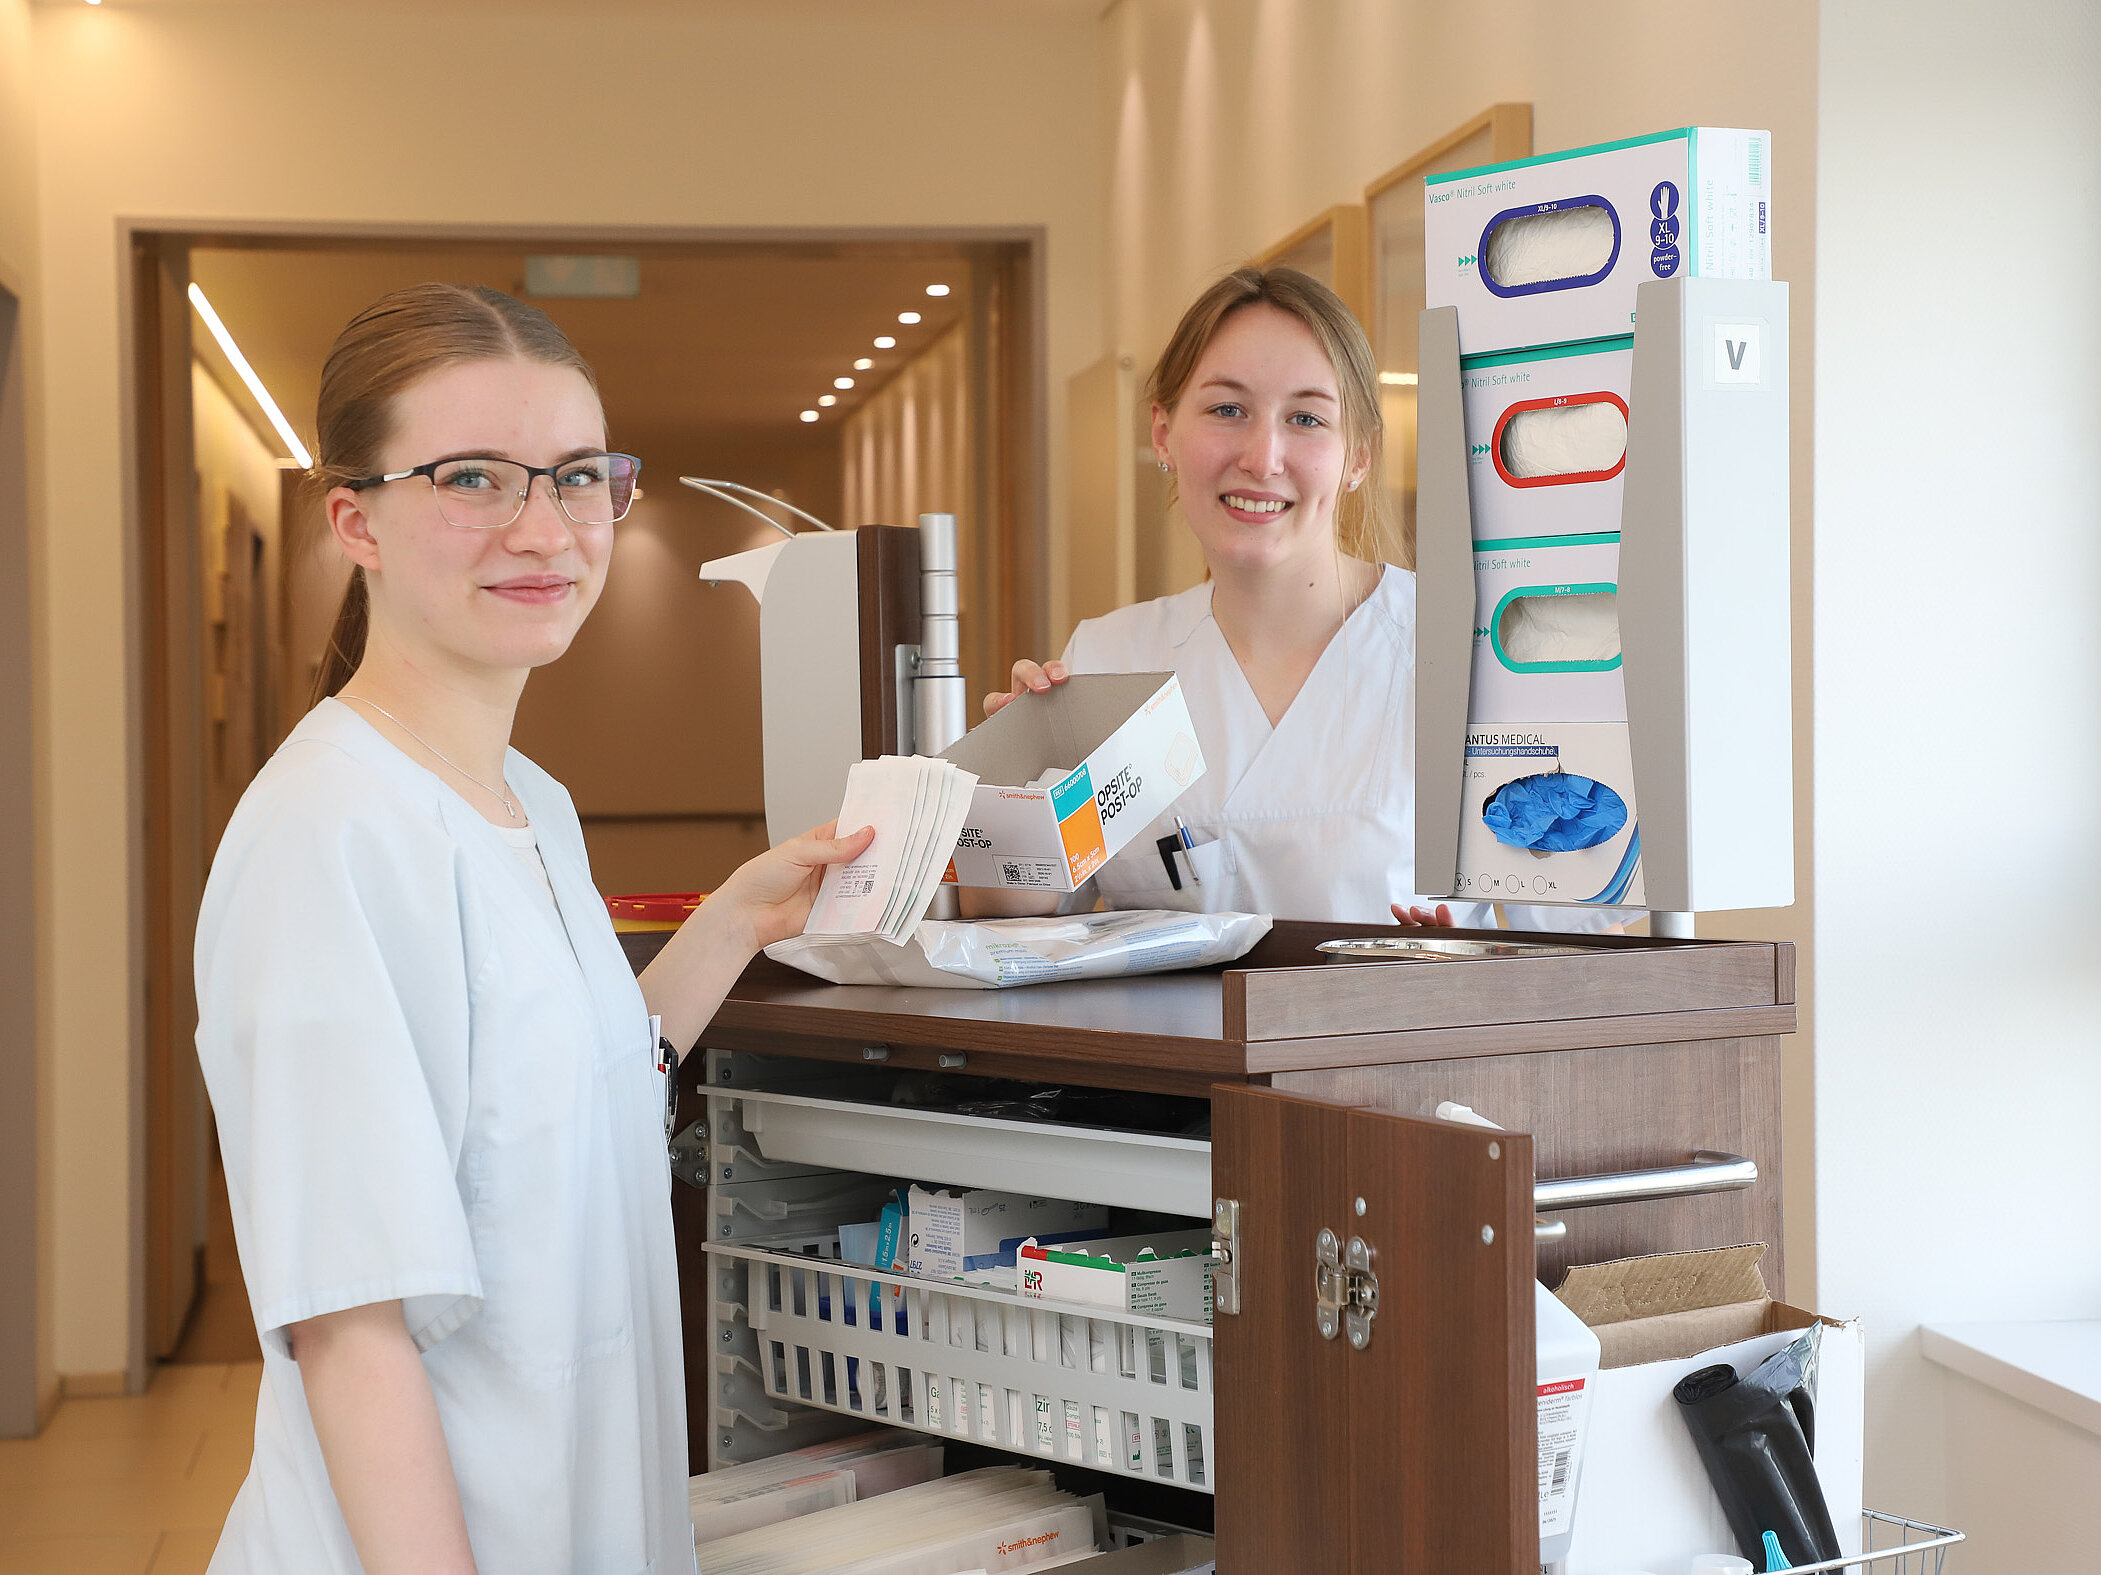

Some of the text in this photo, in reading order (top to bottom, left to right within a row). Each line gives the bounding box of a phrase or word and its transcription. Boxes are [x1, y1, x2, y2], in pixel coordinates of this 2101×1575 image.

[1457, 186, 1475, 199] Nitril
[1478, 184, 1493, 196] Soft
[1495, 180, 1516, 192] white
[1537, 203, 1558, 212] XL/9-10
[1658, 222, 1671, 234] XL
[1706, 180, 1714, 271] Nitril Soft white
[1655, 234, 1675, 246] 9-10
[1653, 254, 1678, 264] powder-
[1659, 263, 1671, 271] free
[1725, 339, 1748, 371] V
[1471, 376, 1490, 388] Nitril
[1492, 374, 1507, 386] Soft
[1510, 372, 1531, 383] white
[1491, 558, 1507, 570] Soft
[1509, 558, 1531, 568] white
[1554, 586, 1571, 594] M/7-8
[1465, 733, 1546, 745] ANTUS MEDICAL
[1101, 776, 1143, 826] POST-OP
[957, 838, 992, 849] OST-OP
[1070, 853, 1079, 864] 100
[1467, 878, 1472, 886] S
[1548, 881, 1557, 889] XL
[910, 1260, 923, 1271] 2797
[1543, 1383, 1575, 1394] alkoholisch
[1008, 1530, 1060, 1552] smith&nephew
